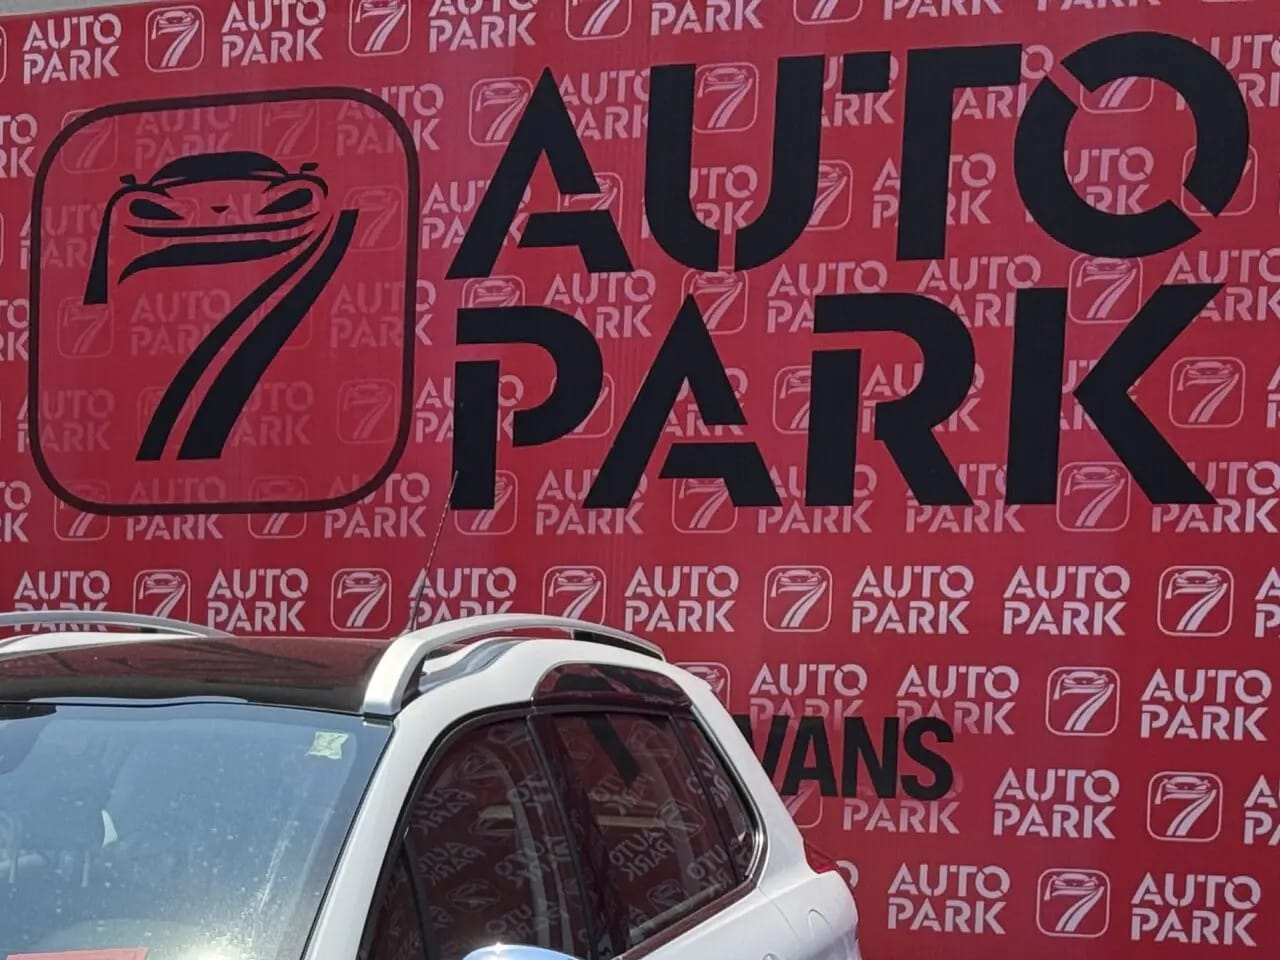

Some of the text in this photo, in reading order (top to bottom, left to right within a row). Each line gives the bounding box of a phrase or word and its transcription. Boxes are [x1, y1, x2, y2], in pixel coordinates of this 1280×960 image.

[21, 12, 122, 53] AUTO
[222, 0, 327, 34] AUTO
[651, 0, 764, 36] PARK
[223, 28, 324, 69] PARK
[429, 17, 536, 55] PARK
[24, 46, 120, 86] PARK
[445, 30, 1250, 278] AUTO
[545, 268, 657, 306] AUTO
[769, 262, 888, 298] AUTO
[917, 255, 1041, 291] AUTO
[450, 282, 1226, 510] PARK
[126, 512, 223, 541] PARK
[326, 507, 426, 538] PARK
[537, 502, 644, 535] PARK
[758, 500, 874, 535] PARK
[907, 498, 1025, 533] PARK
[14, 570, 110, 601] AUTO
[208, 569, 309, 602] AUTO
[410, 567, 517, 599] AUTO
[625, 566, 740, 600] AUTO
[853, 566, 975, 600] AUTO
[1004, 566, 1131, 601] AUTO
[205, 601, 306, 632] PARK
[623, 600, 736, 635] PARK
[853, 600, 971, 635] PARK
[1004, 600, 1127, 637] PARK
[750, 664, 868, 698] AUTO
[897, 666, 1020, 701] AUTO
[1142, 669, 1273, 705] AUTO
[1141, 705, 1269, 742] PARK
[995, 769, 1121, 805] AUTO
[842, 799, 960, 834] PARK
[994, 803, 1116, 840] PARK
[889, 864, 1011, 900] AUTO
[1132, 874, 1262, 911] AUTO
[889, 897, 1007, 935] PARK
[1132, 908, 1257, 947] PARK
